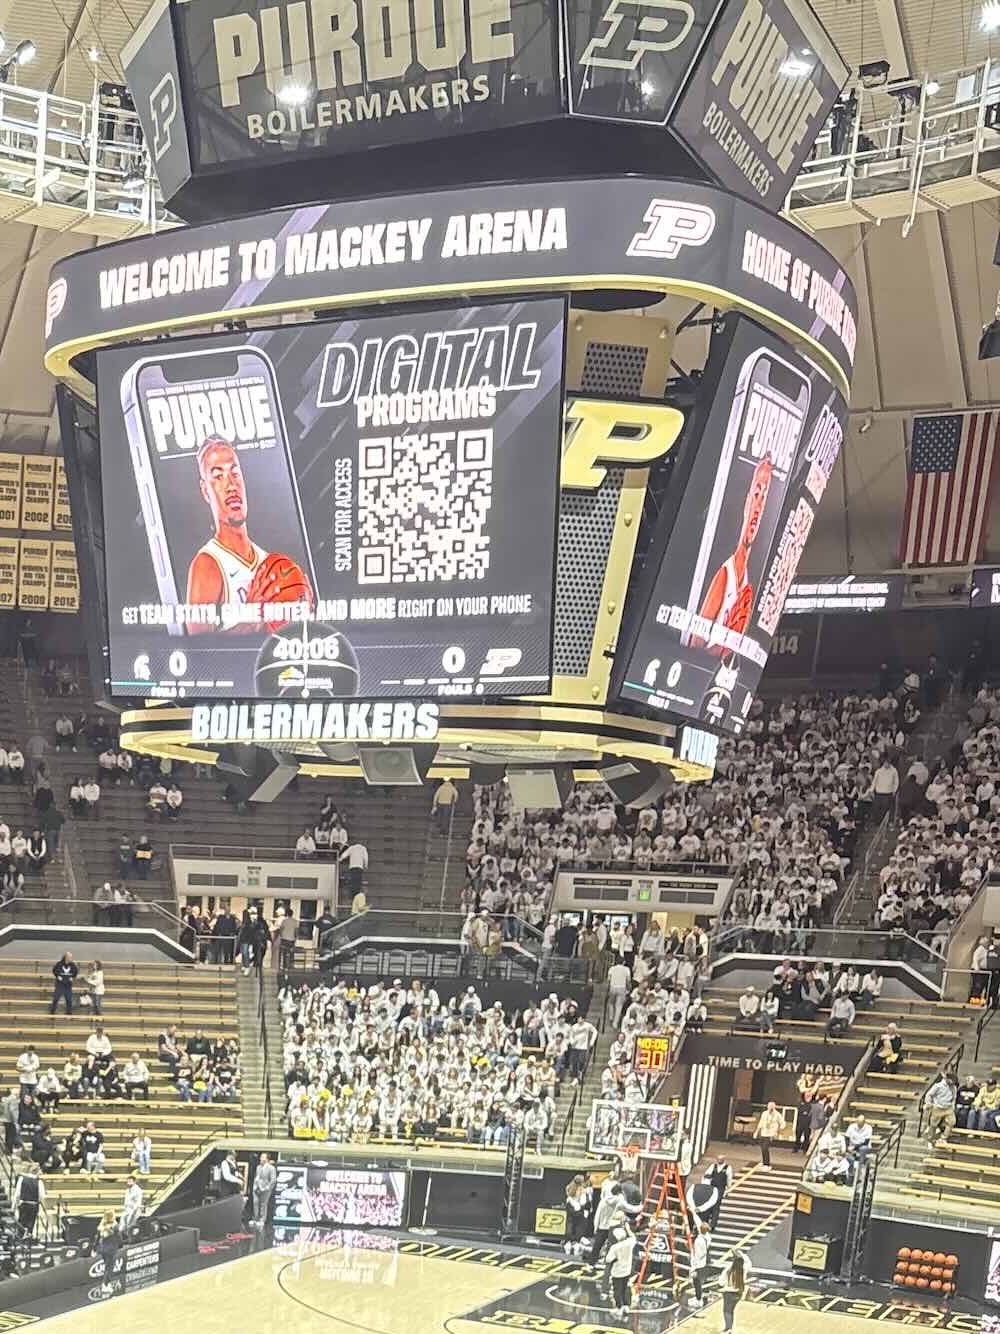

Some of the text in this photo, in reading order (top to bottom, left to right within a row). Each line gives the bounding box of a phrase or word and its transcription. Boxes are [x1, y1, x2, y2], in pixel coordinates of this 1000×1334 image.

[213, 0, 515, 107] PURDUE
[247, 75, 490, 139] BOILERMAKERS
[712, 0, 824, 175] PURDUE
[702, 101, 775, 197] BOILERMAKERS
[99, 208, 568, 309] WELCOME TO MACKEY ARENA
[742, 229, 792, 293] HOME
[790, 257, 811, 303] OF
[316, 322, 542, 408] DIGITAL
[147, 385, 275, 453] PURDUE
[356, 384, 497, 428] PROGRAMS
[25, 512, 48, 522] 2002
[334, 458, 352, 571] SCAN FOR ACCESS
[316, 599, 348, 621] AND
[350, 597, 396, 619] MORE
[398, 599, 435, 618] RIGHT
[437, 598, 454, 617] ON
[455, 596, 488, 616] YOUR
[490, 594, 532, 615] PHONE
[168, 650, 188, 676] 0
[442, 646, 466, 673] 0
[191, 702, 440, 742] BOILERMAKERS
[638, 1050, 665, 1070] 30
[707, 1055, 844, 1075] TIME TO PLAY HARD
